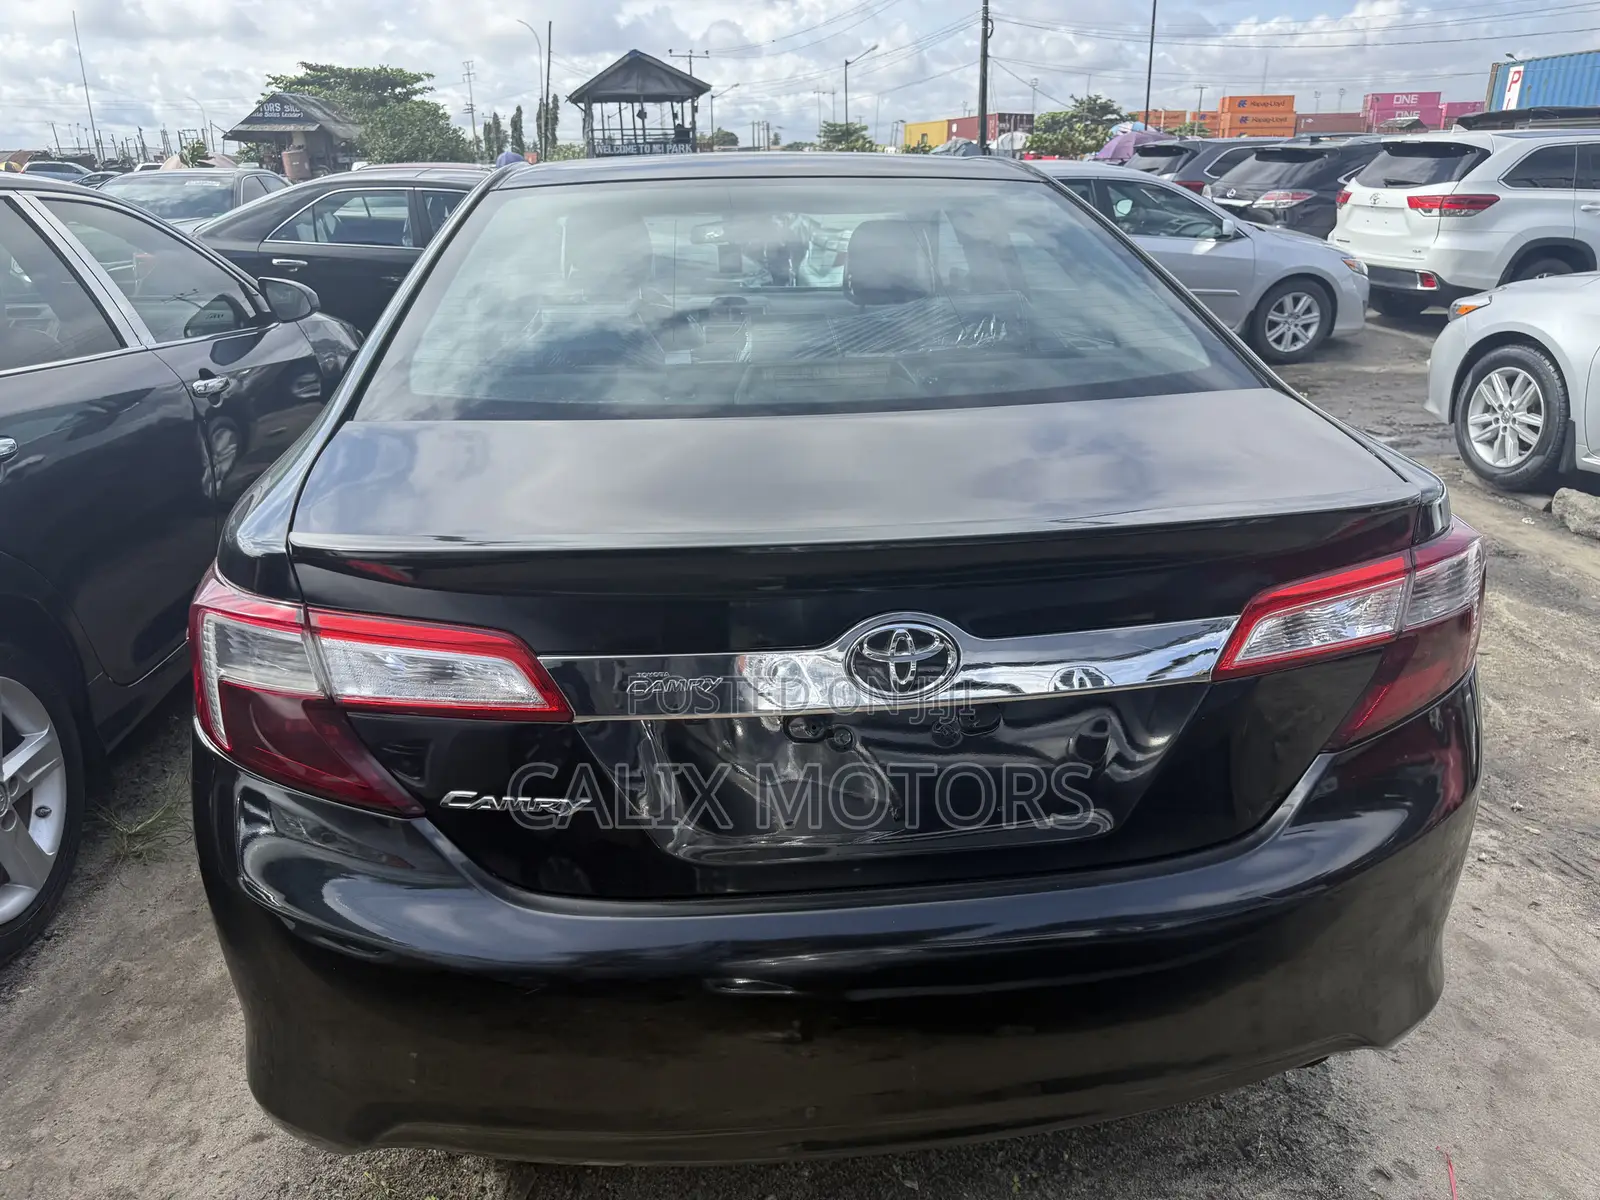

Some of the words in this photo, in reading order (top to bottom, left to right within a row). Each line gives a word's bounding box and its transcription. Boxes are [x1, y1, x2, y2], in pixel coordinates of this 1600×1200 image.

[1393, 94, 1418, 105] ONE
[595, 144, 637, 154] WELCOME
[639, 144, 651, 154] TO
[666, 144, 693, 154] PARK
[626, 677, 724, 694] CAMRY
[439, 790, 592, 817] CAMRY
